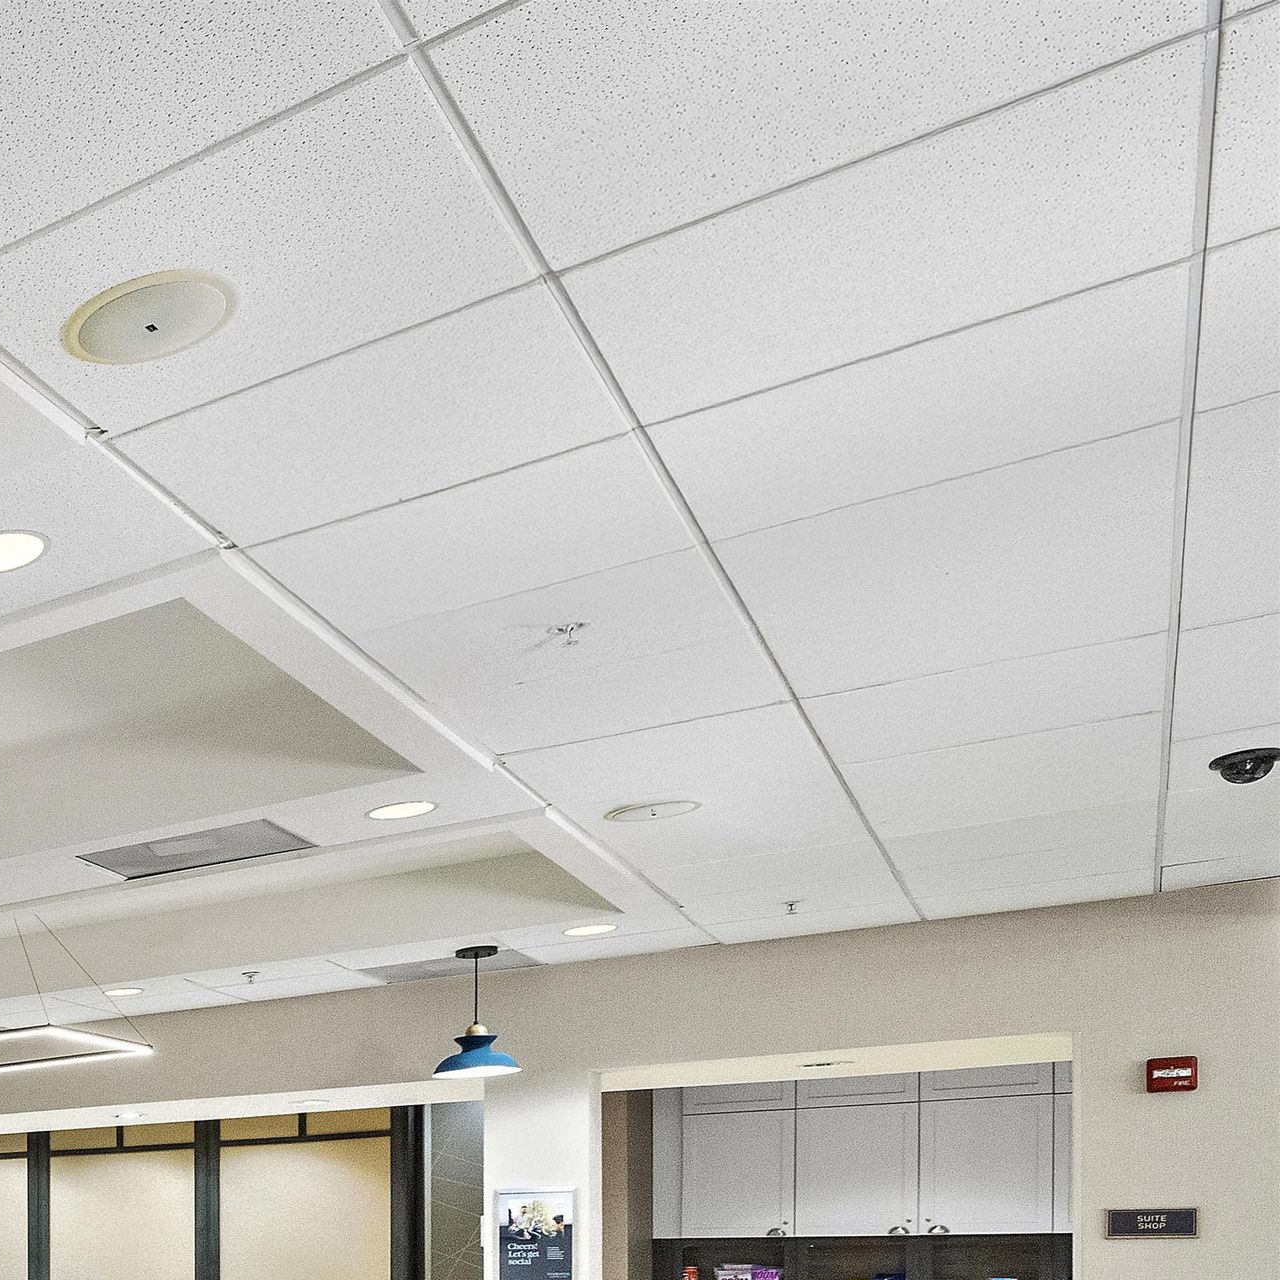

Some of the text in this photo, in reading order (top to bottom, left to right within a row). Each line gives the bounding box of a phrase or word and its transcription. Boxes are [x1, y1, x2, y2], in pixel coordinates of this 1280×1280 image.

[1136, 1214, 1167, 1222] SUITE
[1137, 1222, 1166, 1230] SHOP
[527, 1251, 540, 1259] get
[508, 1258, 532, 1266] social
